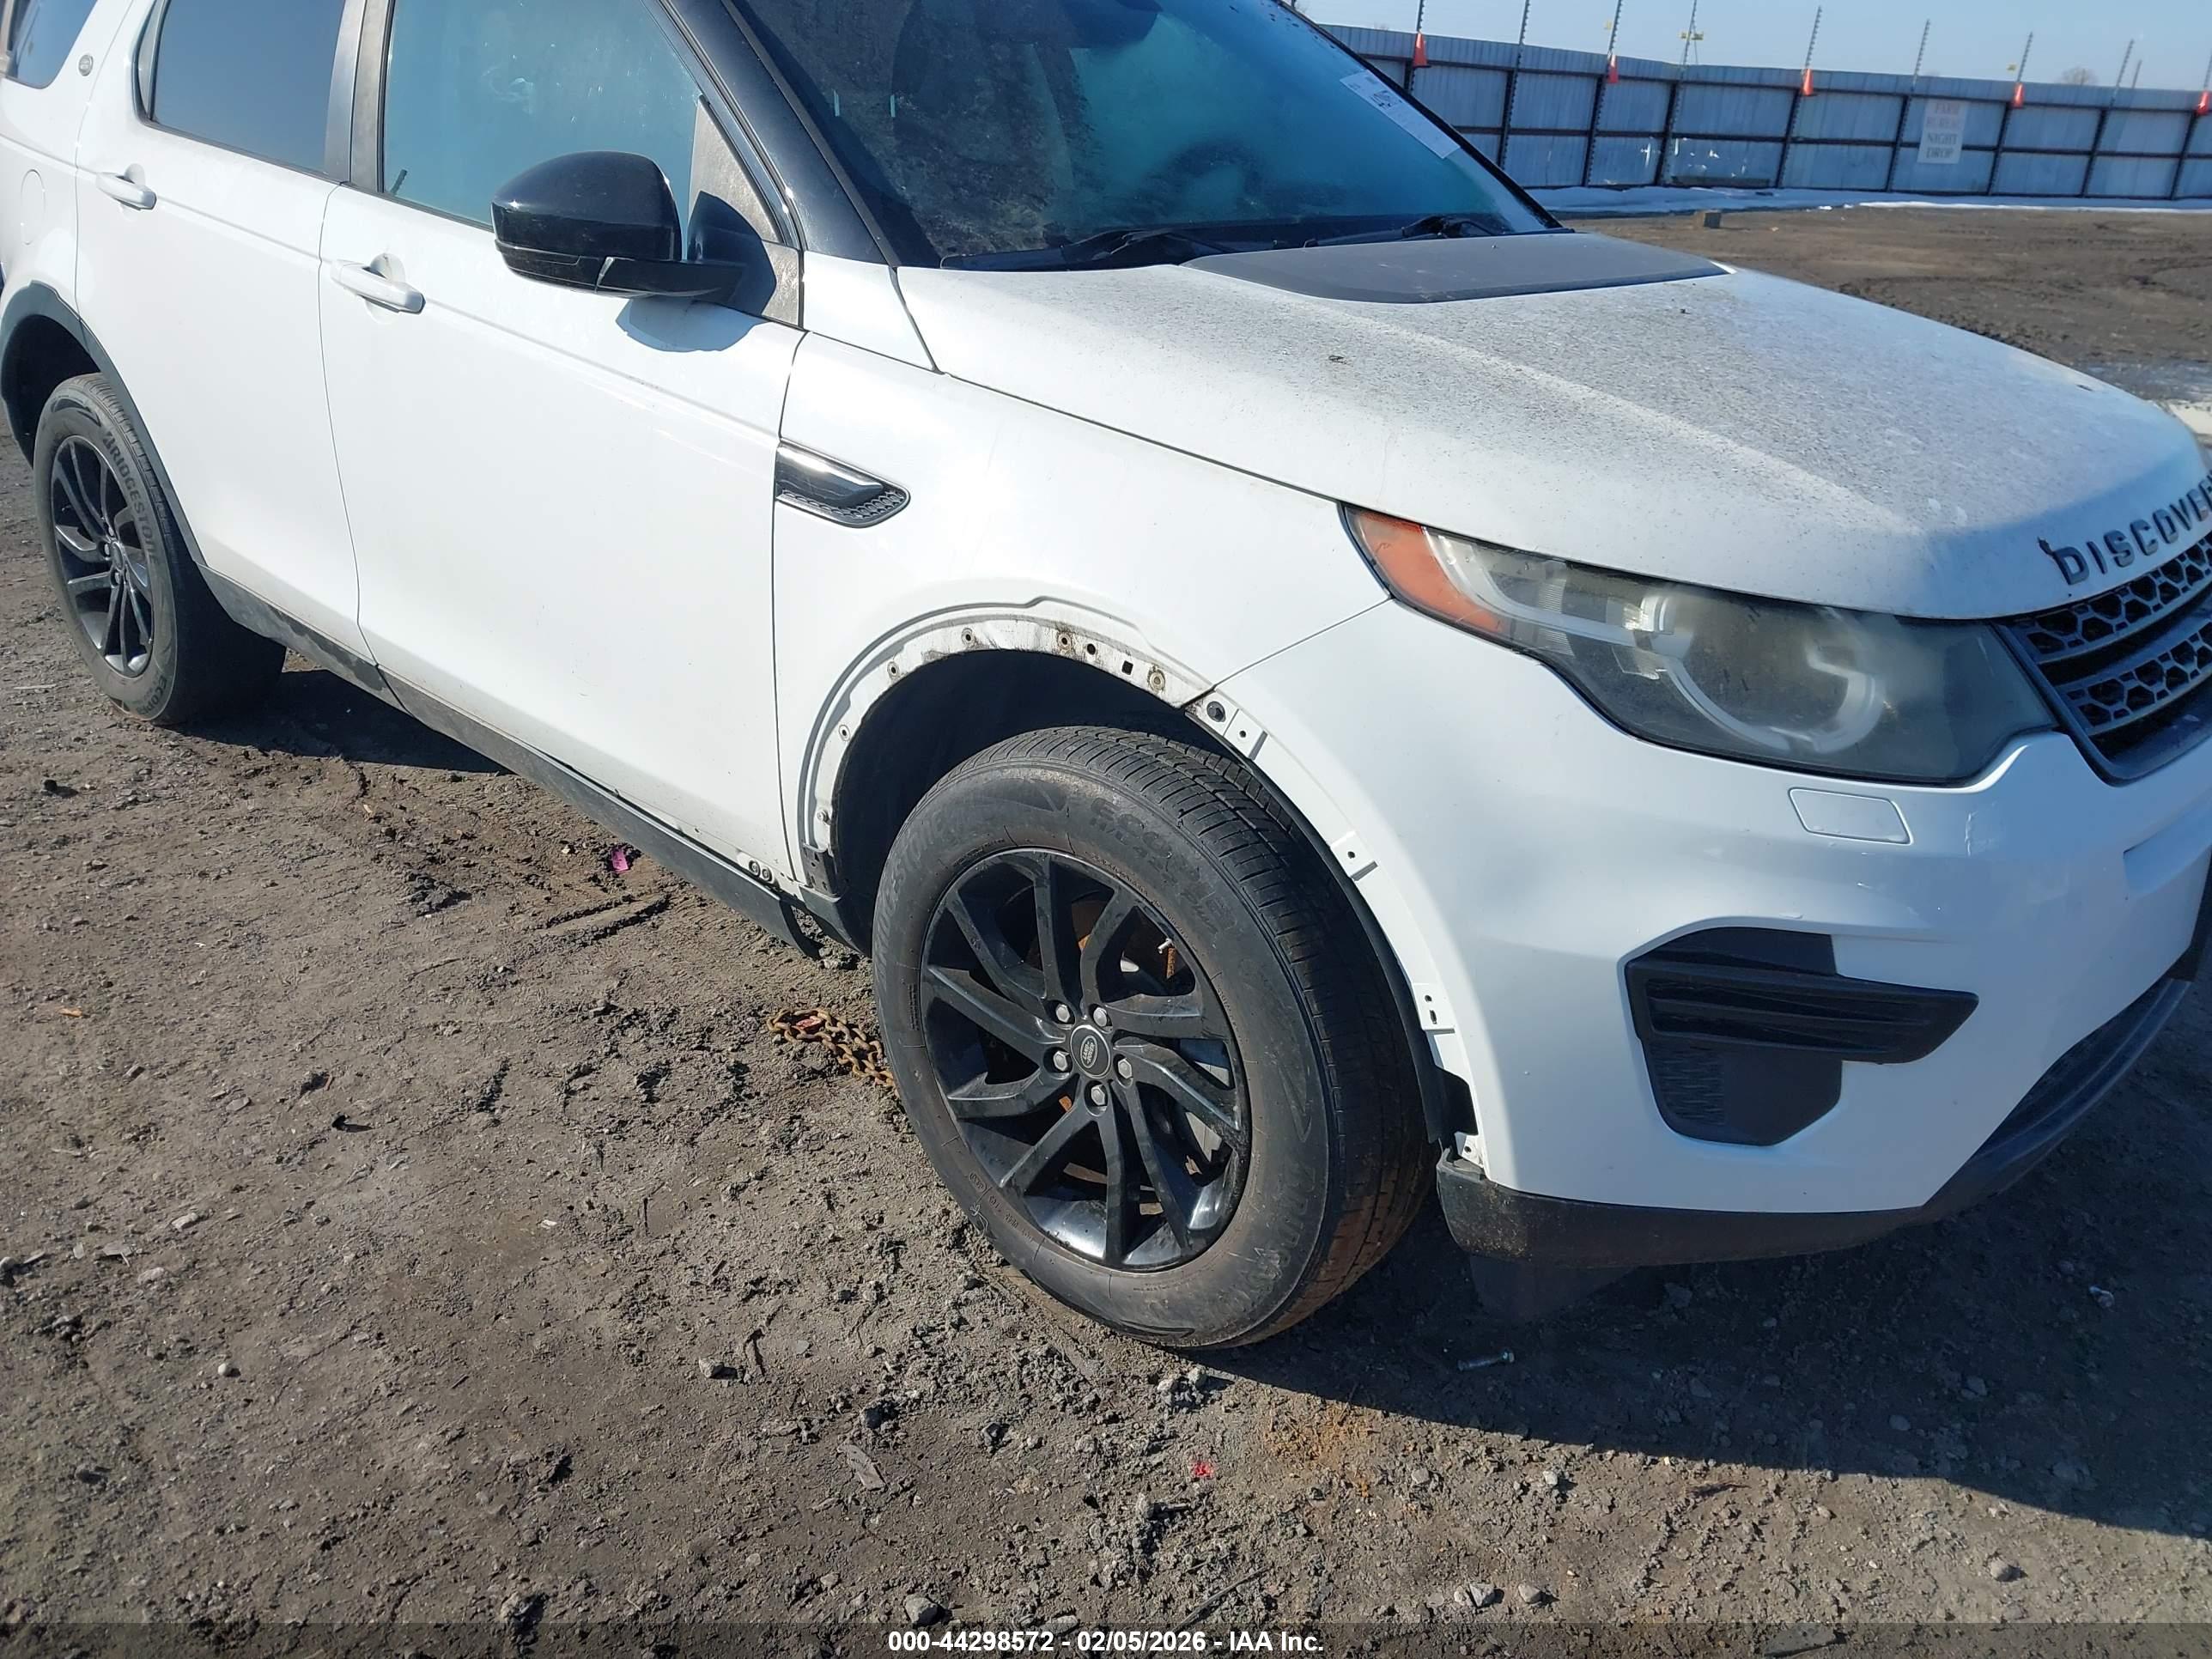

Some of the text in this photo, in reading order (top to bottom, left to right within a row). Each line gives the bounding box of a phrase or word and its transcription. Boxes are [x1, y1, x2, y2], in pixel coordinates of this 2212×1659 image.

[1925, 147, 1954, 158] DROP
[1927, 132, 1958, 144] NIGHT
[102, 431, 158, 564] BRIDGESTONE
[2051, 471, 2212, 586] DISCOVER
